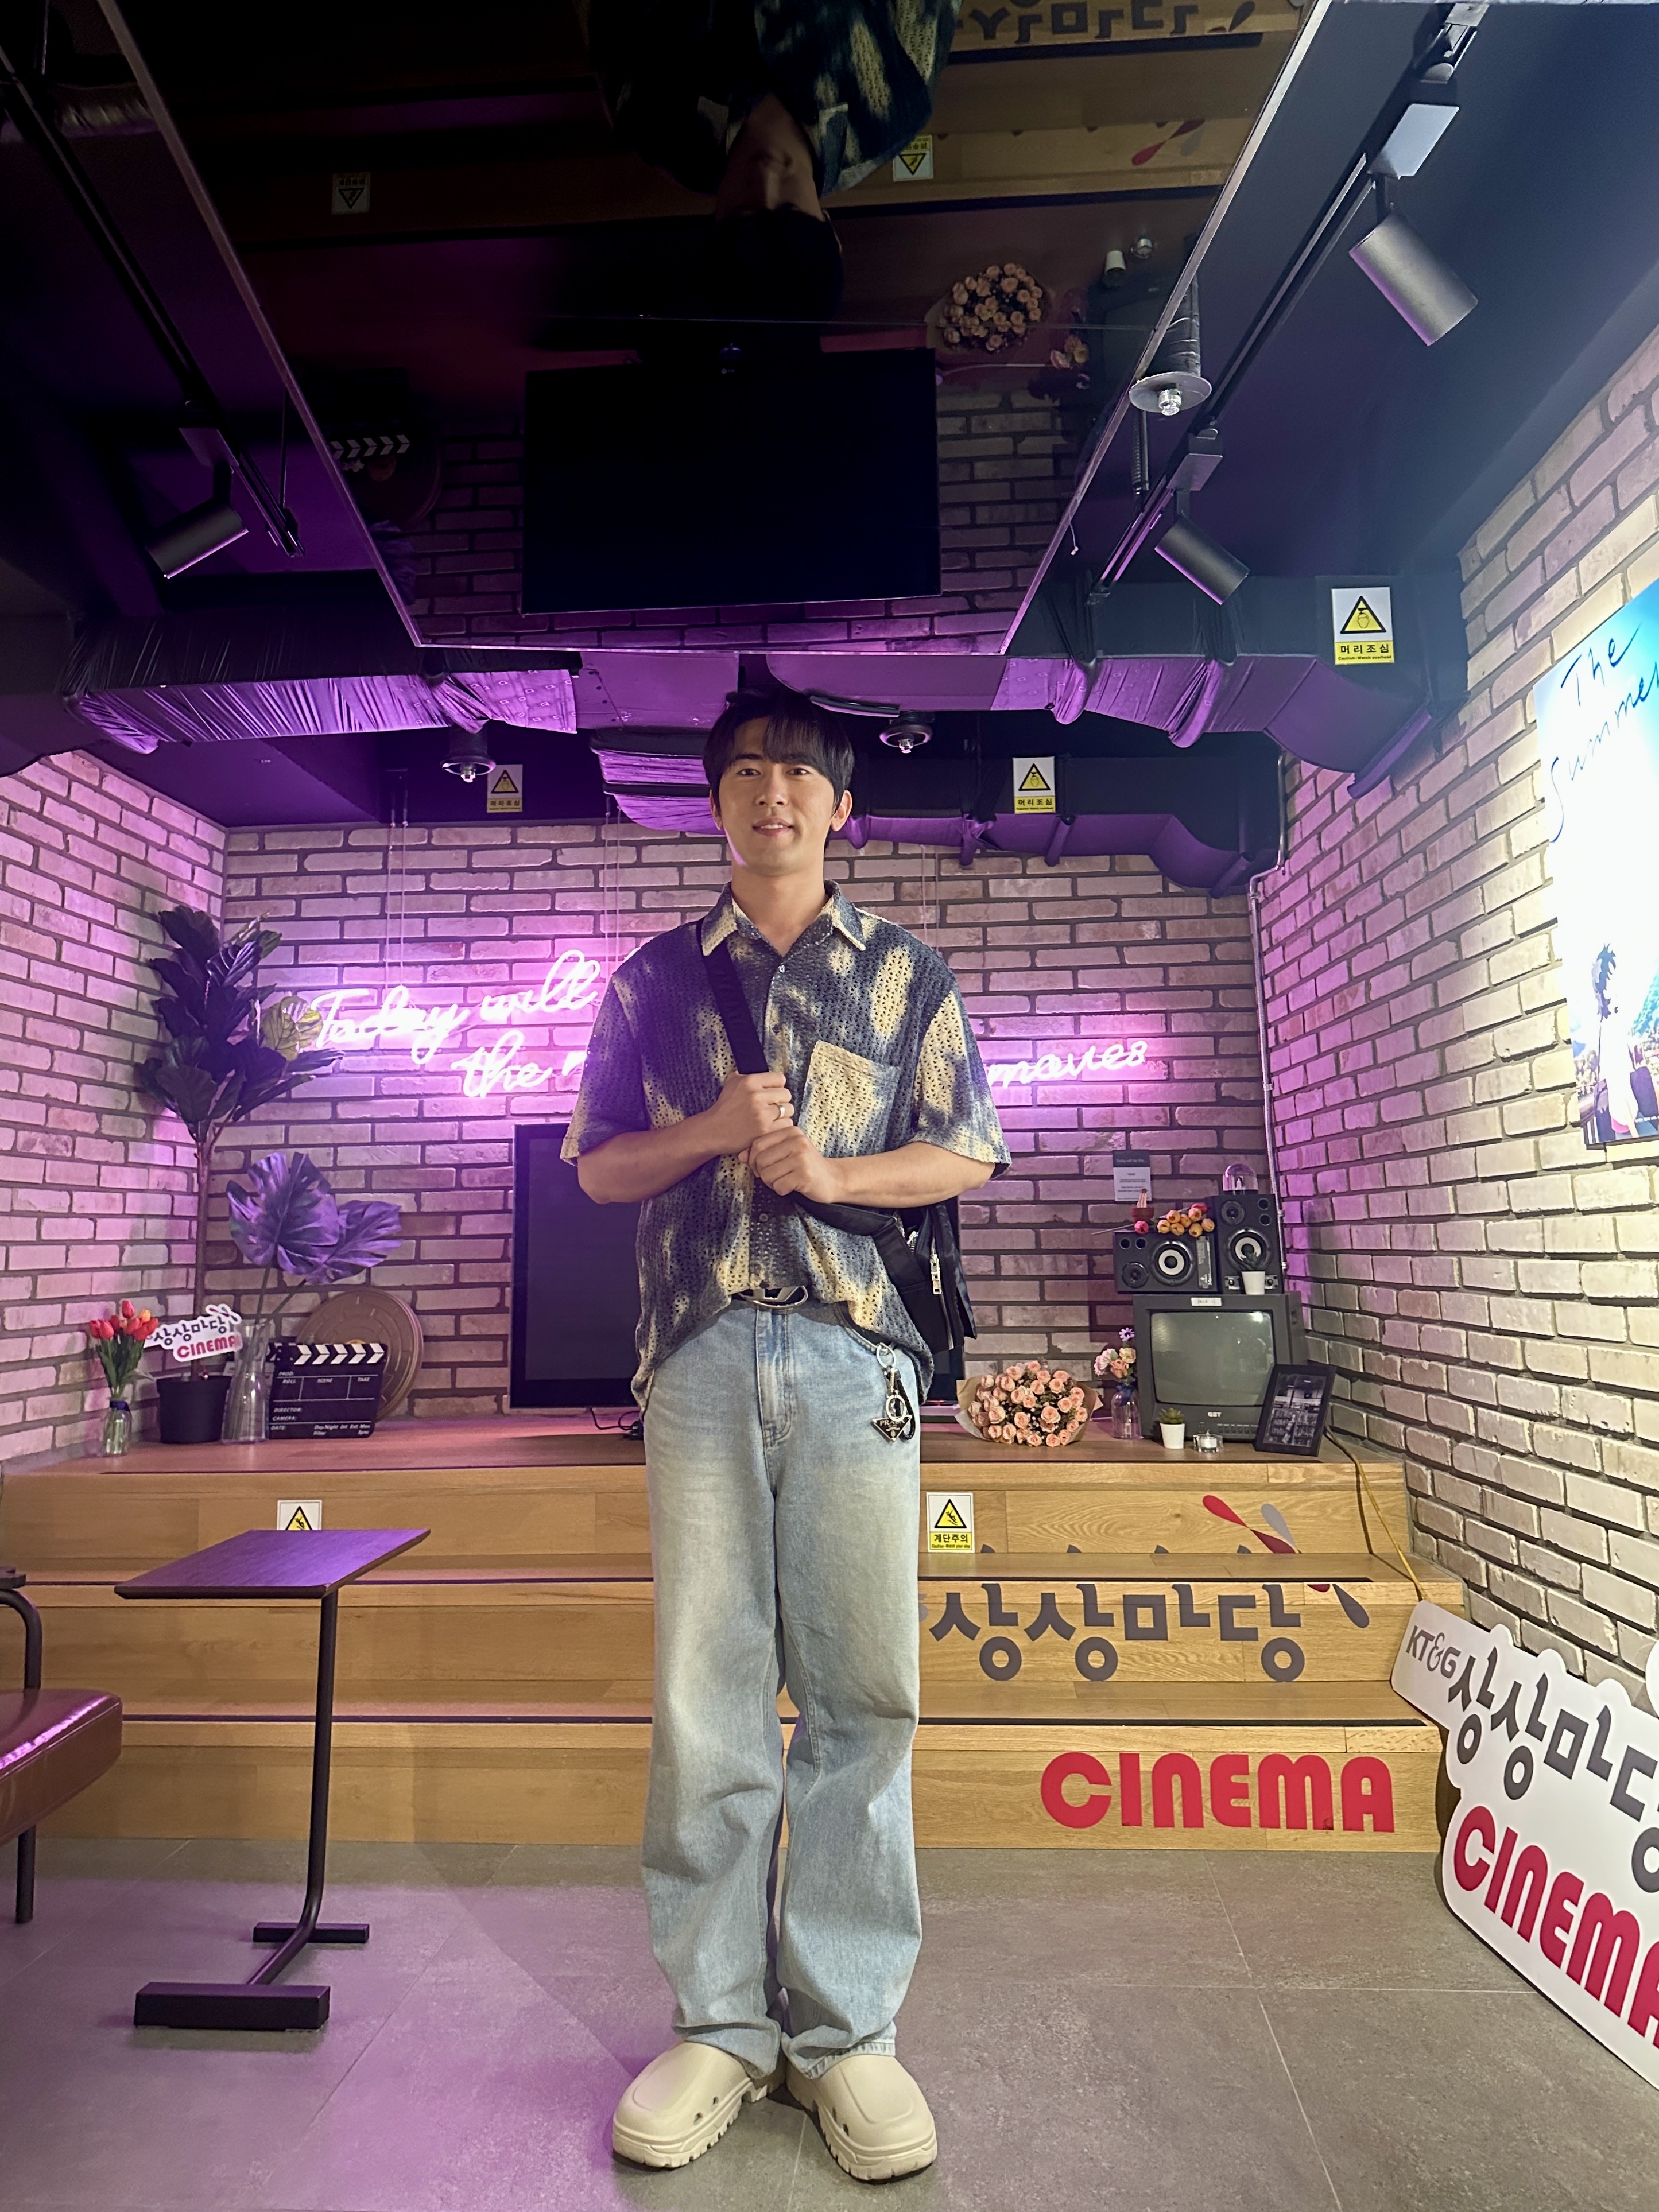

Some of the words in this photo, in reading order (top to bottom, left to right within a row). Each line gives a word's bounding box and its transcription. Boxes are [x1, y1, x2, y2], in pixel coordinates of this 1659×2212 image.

[1340, 643, 1389, 654] 머리조심
[1561, 621, 1642, 707] The
[312, 985, 468, 1065] Today
[479, 950, 601, 1022] will
[450, 1030, 553, 1098] the
[154, 1316, 227, 1345] 상상마당
[934, 1534, 968, 1543] 계단주의
[929, 1583, 1305, 1682] 상상마당
[1406, 1625, 1462, 1679] KT&G
[1041, 1752, 1394, 1833] CINEMA
